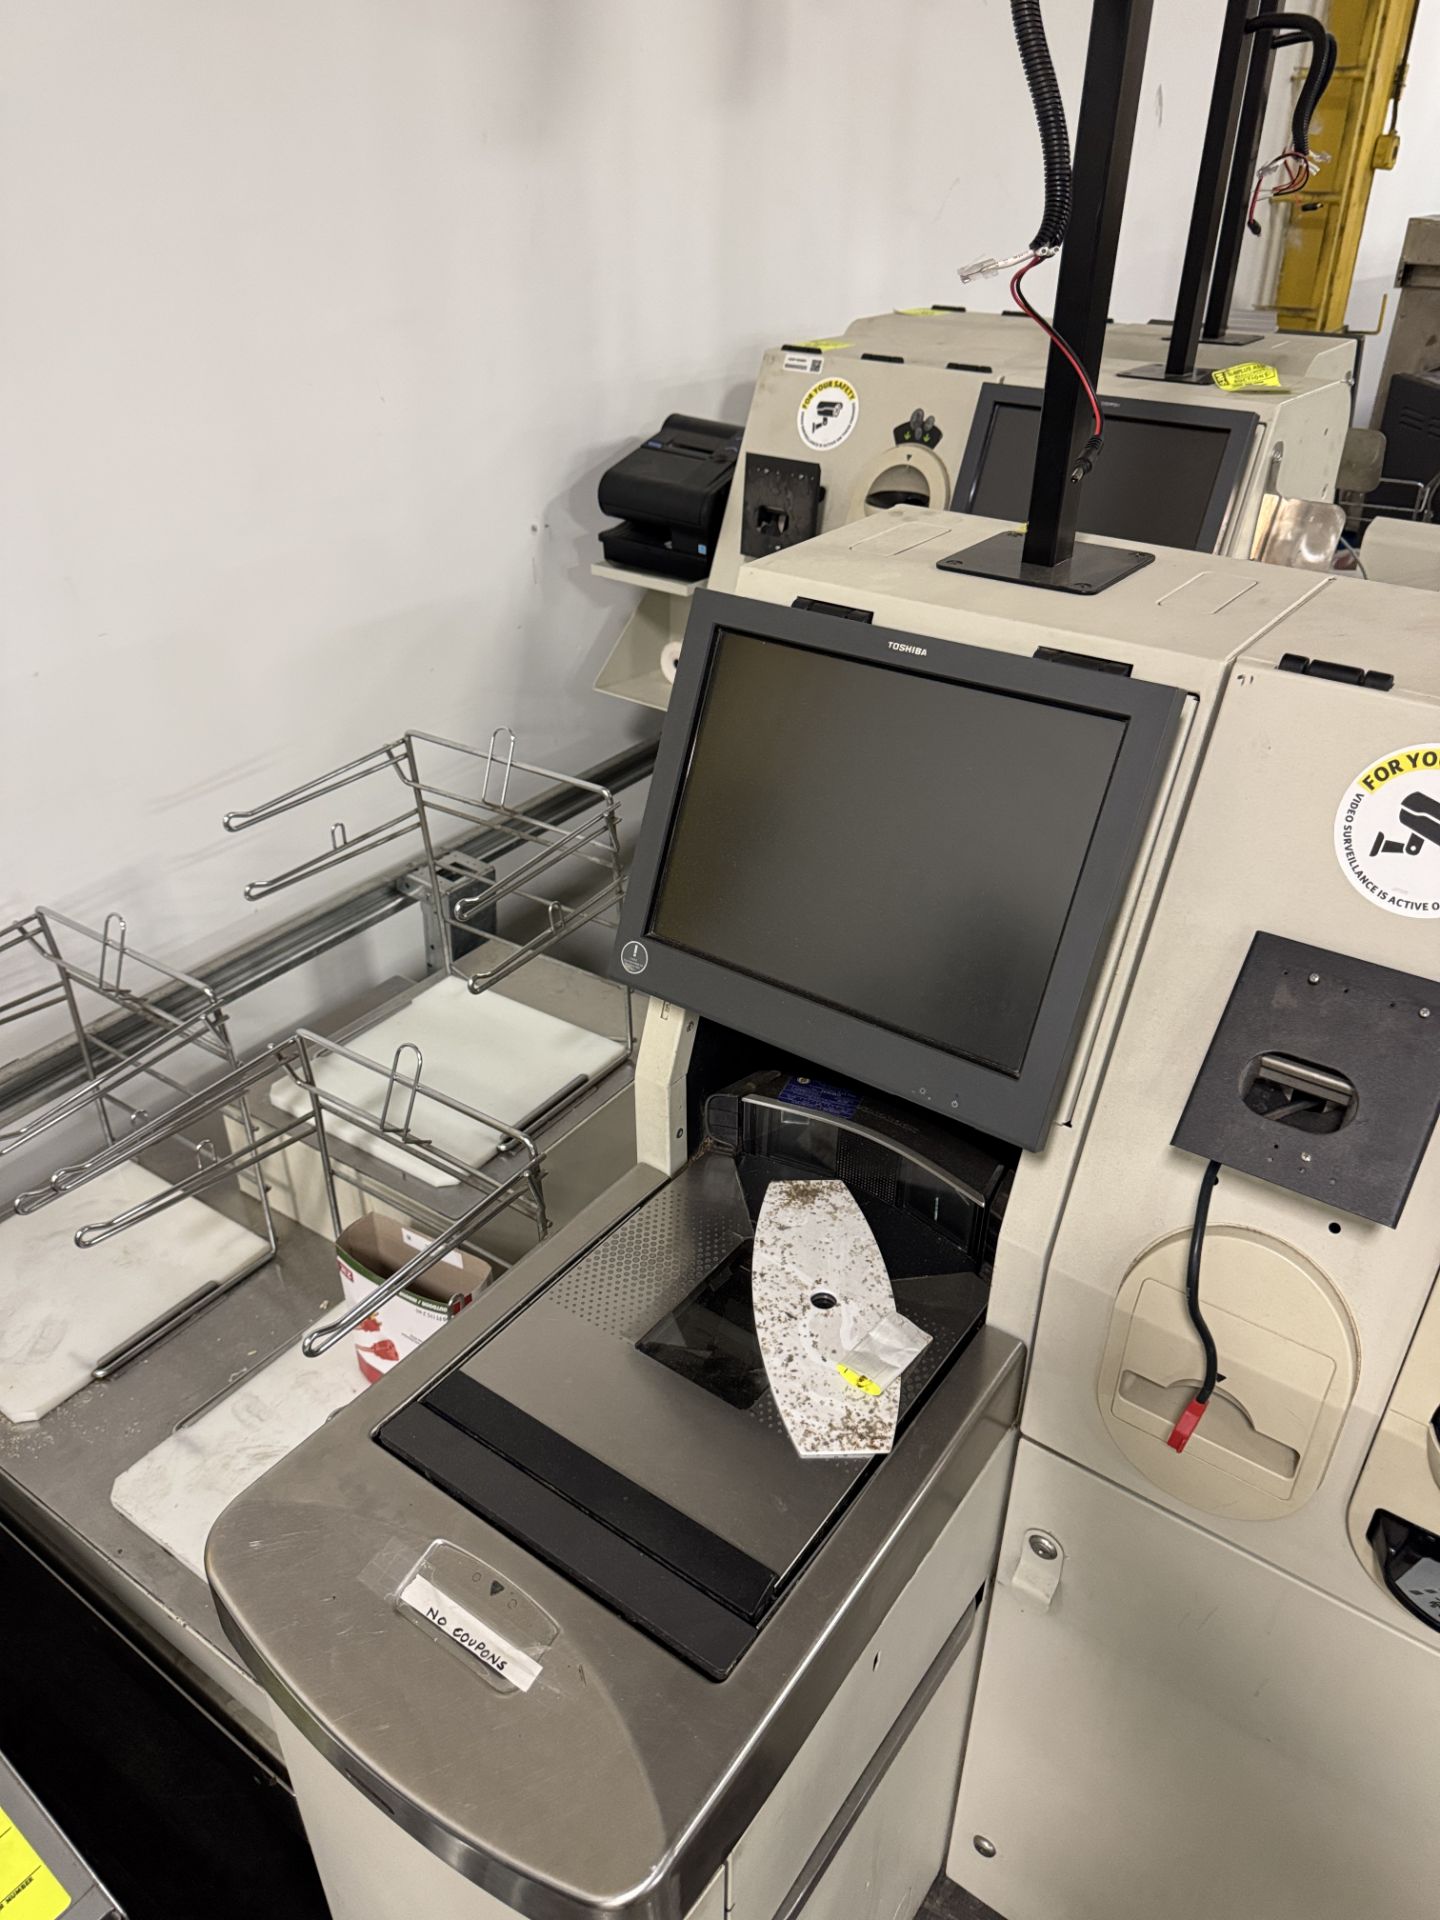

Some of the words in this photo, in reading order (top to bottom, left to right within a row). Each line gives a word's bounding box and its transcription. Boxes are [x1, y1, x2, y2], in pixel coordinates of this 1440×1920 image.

[802, 394, 814, 409] FOR
[813, 381, 833, 394] YOUR
[834, 381, 856, 400] SAFETY
[888, 641, 928, 656] TOSHIBA
[1362, 759, 1404, 791] FOR
[1406, 751, 1440, 768] YO
[1344, 793, 1365, 823] VIDEO
[1343, 825, 1379, 894] SURVEILLANCE
[1377, 890, 1388, 900] IS
[1387, 896, 1429, 911] ACTIVE
[426, 1607, 447, 1626] NO
[452, 1627, 508, 1671] COUPONS
[5, 1875, 34, 1904] NUMBER
